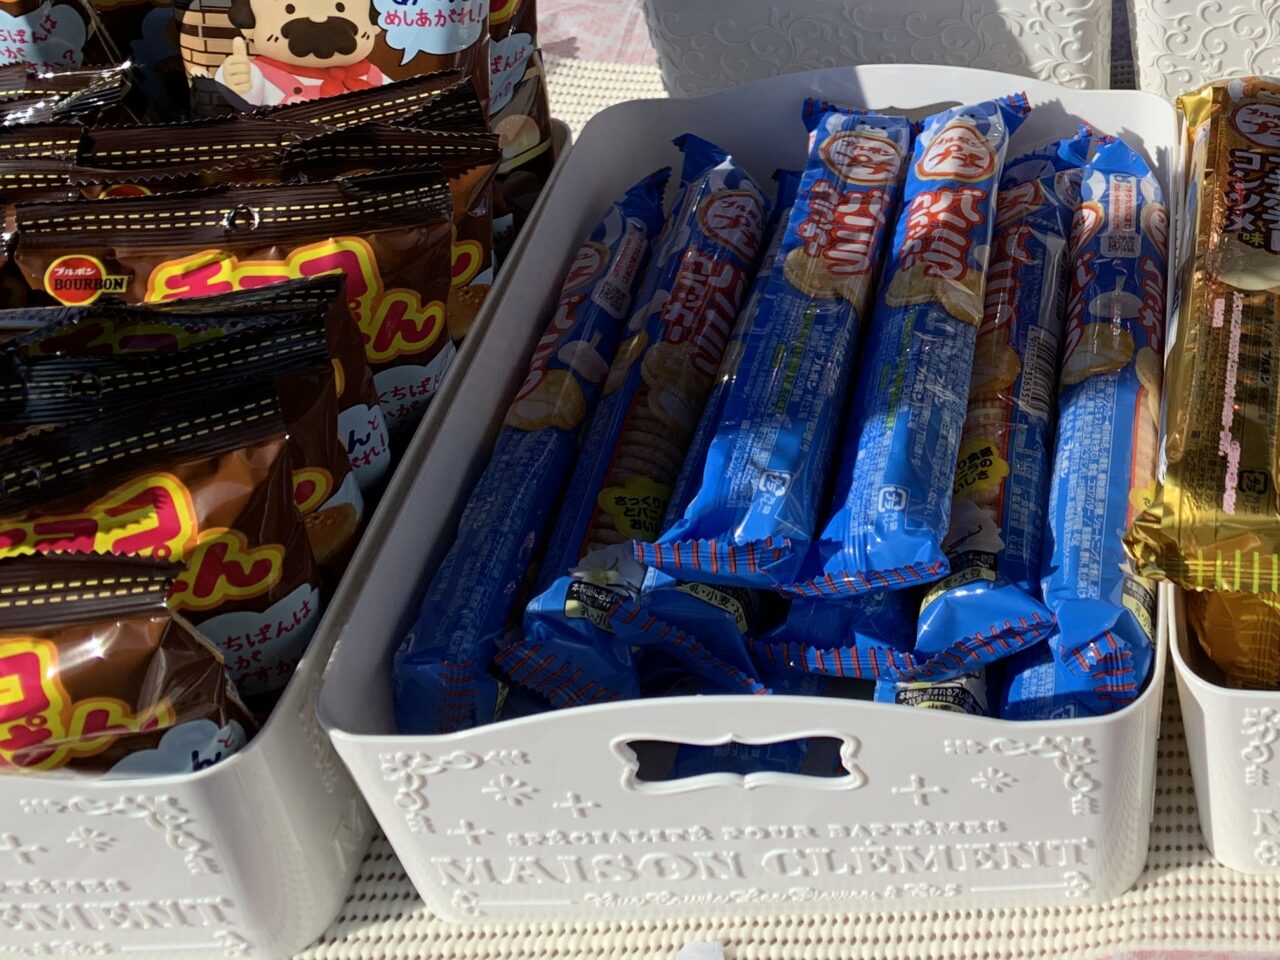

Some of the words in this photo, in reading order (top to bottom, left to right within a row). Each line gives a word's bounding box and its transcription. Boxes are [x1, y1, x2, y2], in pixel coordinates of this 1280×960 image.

[927, 144, 986, 173] プチ
[53, 265, 96, 277] ブルボン
[53, 276, 125, 292] BOURBON
[721, 824, 817, 840] POUR
[430, 849, 749, 886] MAISON
